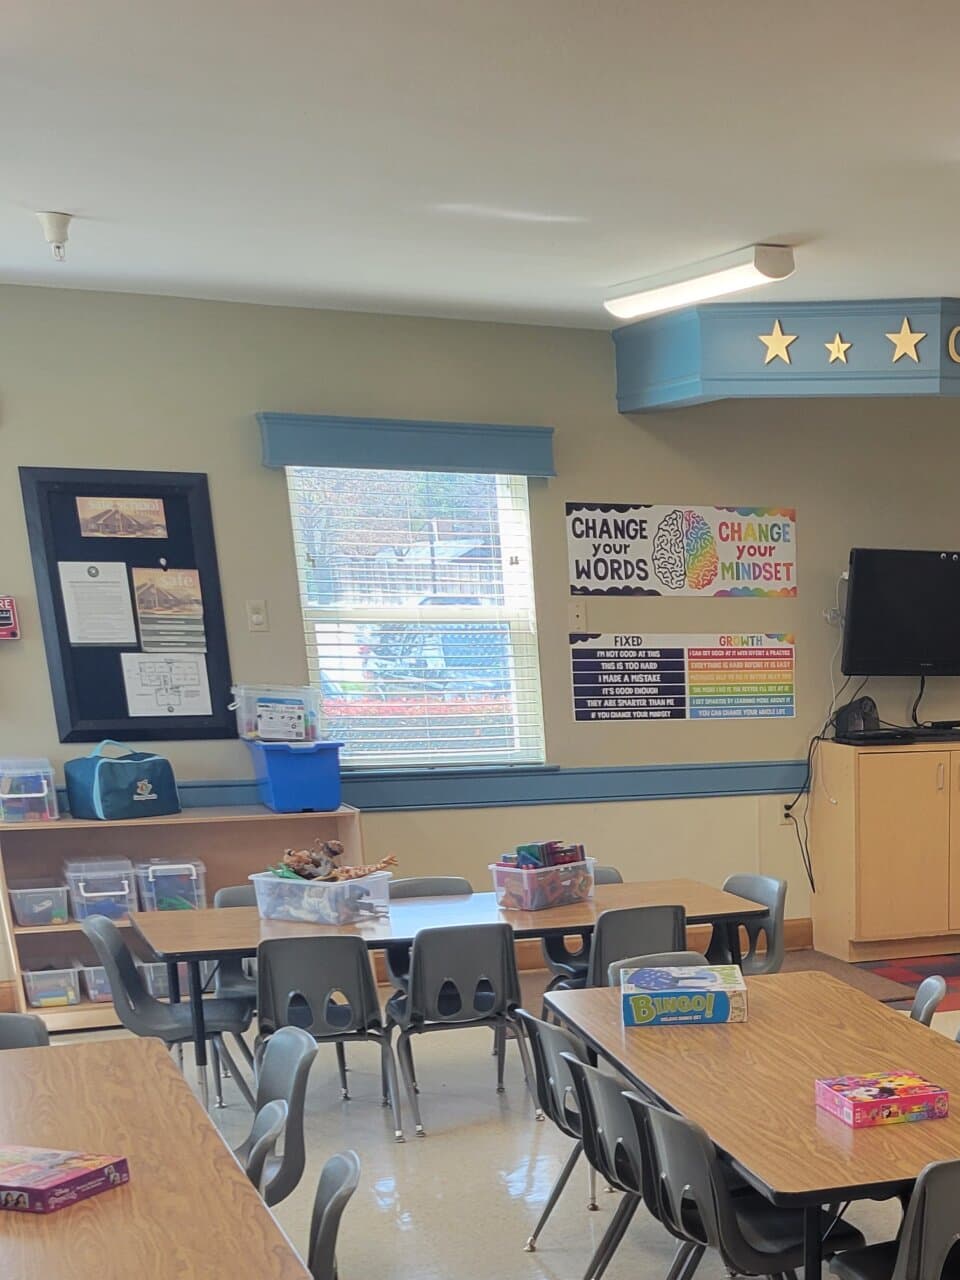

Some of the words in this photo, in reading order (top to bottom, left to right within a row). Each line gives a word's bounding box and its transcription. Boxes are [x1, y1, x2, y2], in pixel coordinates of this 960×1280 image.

[572, 517, 648, 540] CHANGE
[719, 521, 791, 542] CHANGE
[592, 543, 630, 557] your
[736, 545, 776, 560] your
[575, 558, 649, 581] WORDS
[721, 562, 793, 581] MINDSET
[614, 636, 642, 646] FIXED
[720, 636, 762, 646] GROWTH
[630, 993, 715, 1024] BINGO!
